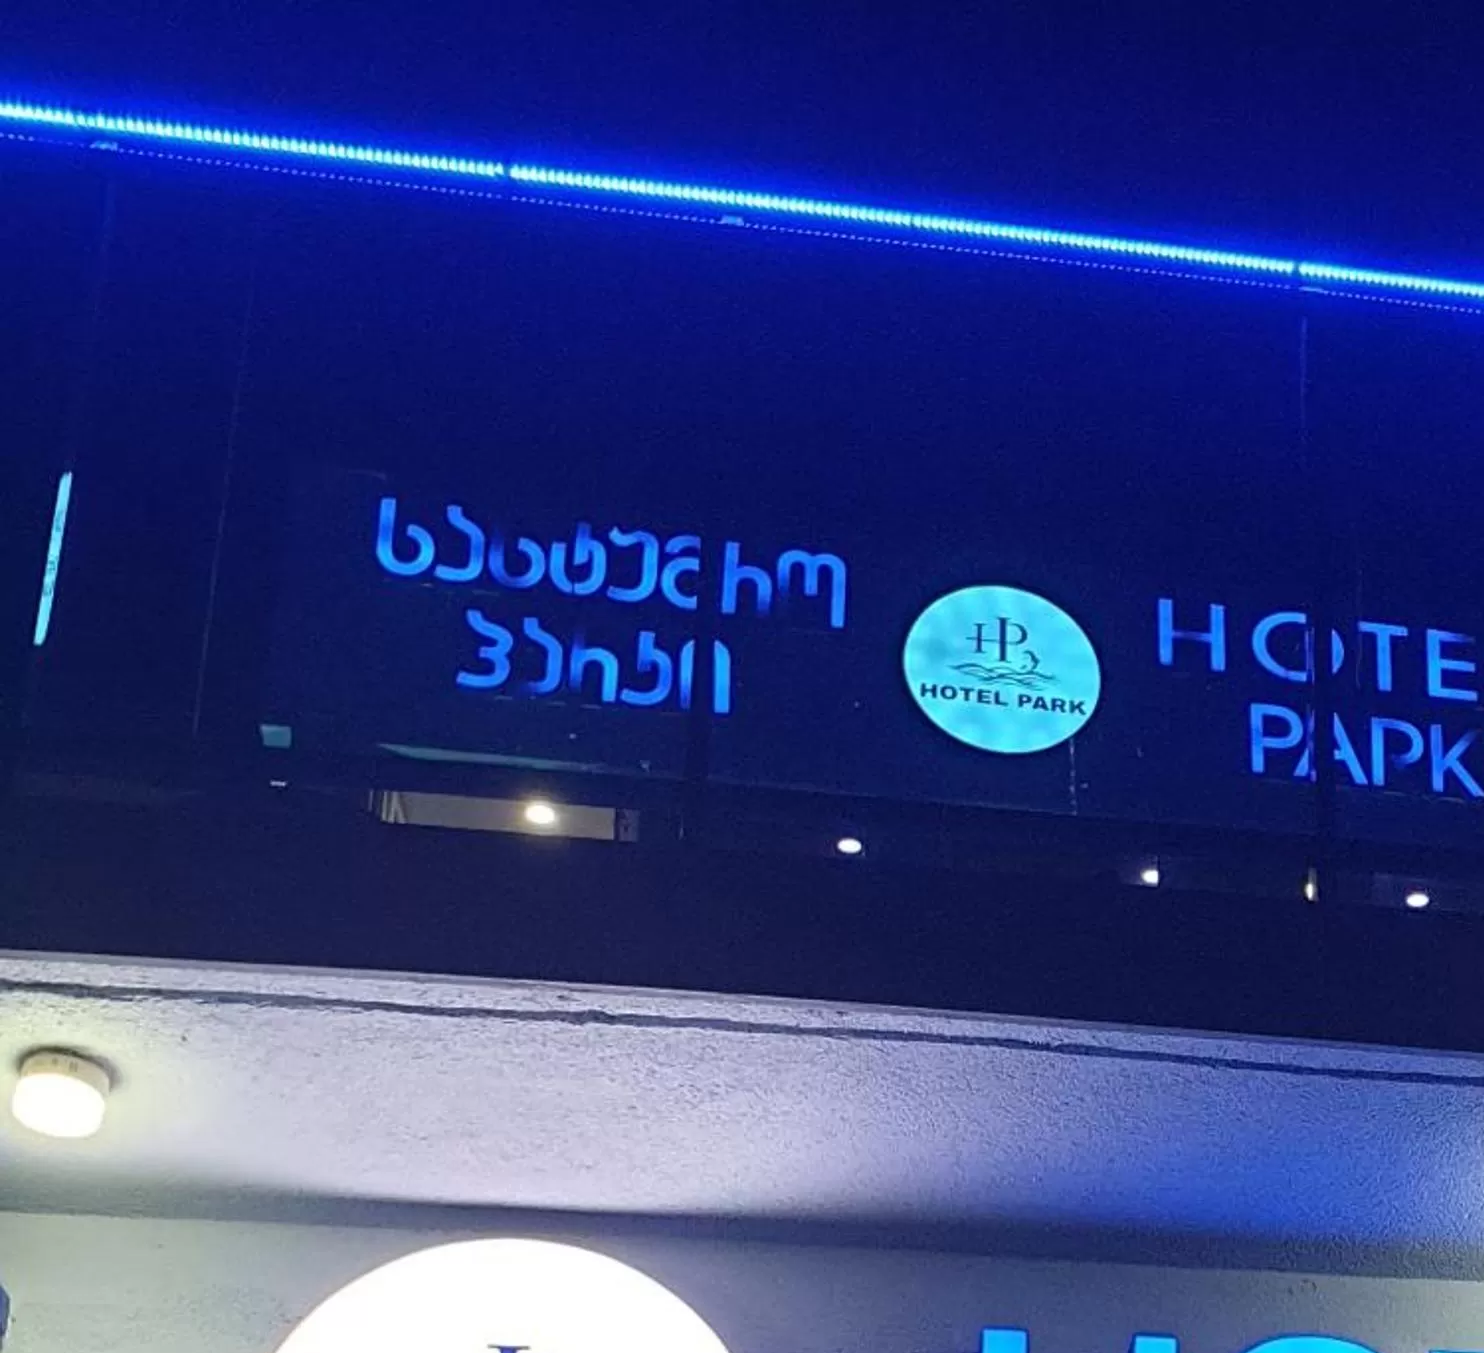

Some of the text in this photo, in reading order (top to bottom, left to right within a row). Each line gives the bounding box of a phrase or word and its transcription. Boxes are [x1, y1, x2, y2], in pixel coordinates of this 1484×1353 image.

[374, 497, 847, 628] სასტუმრო
[919, 682, 1087, 716] HOTEL PARK
